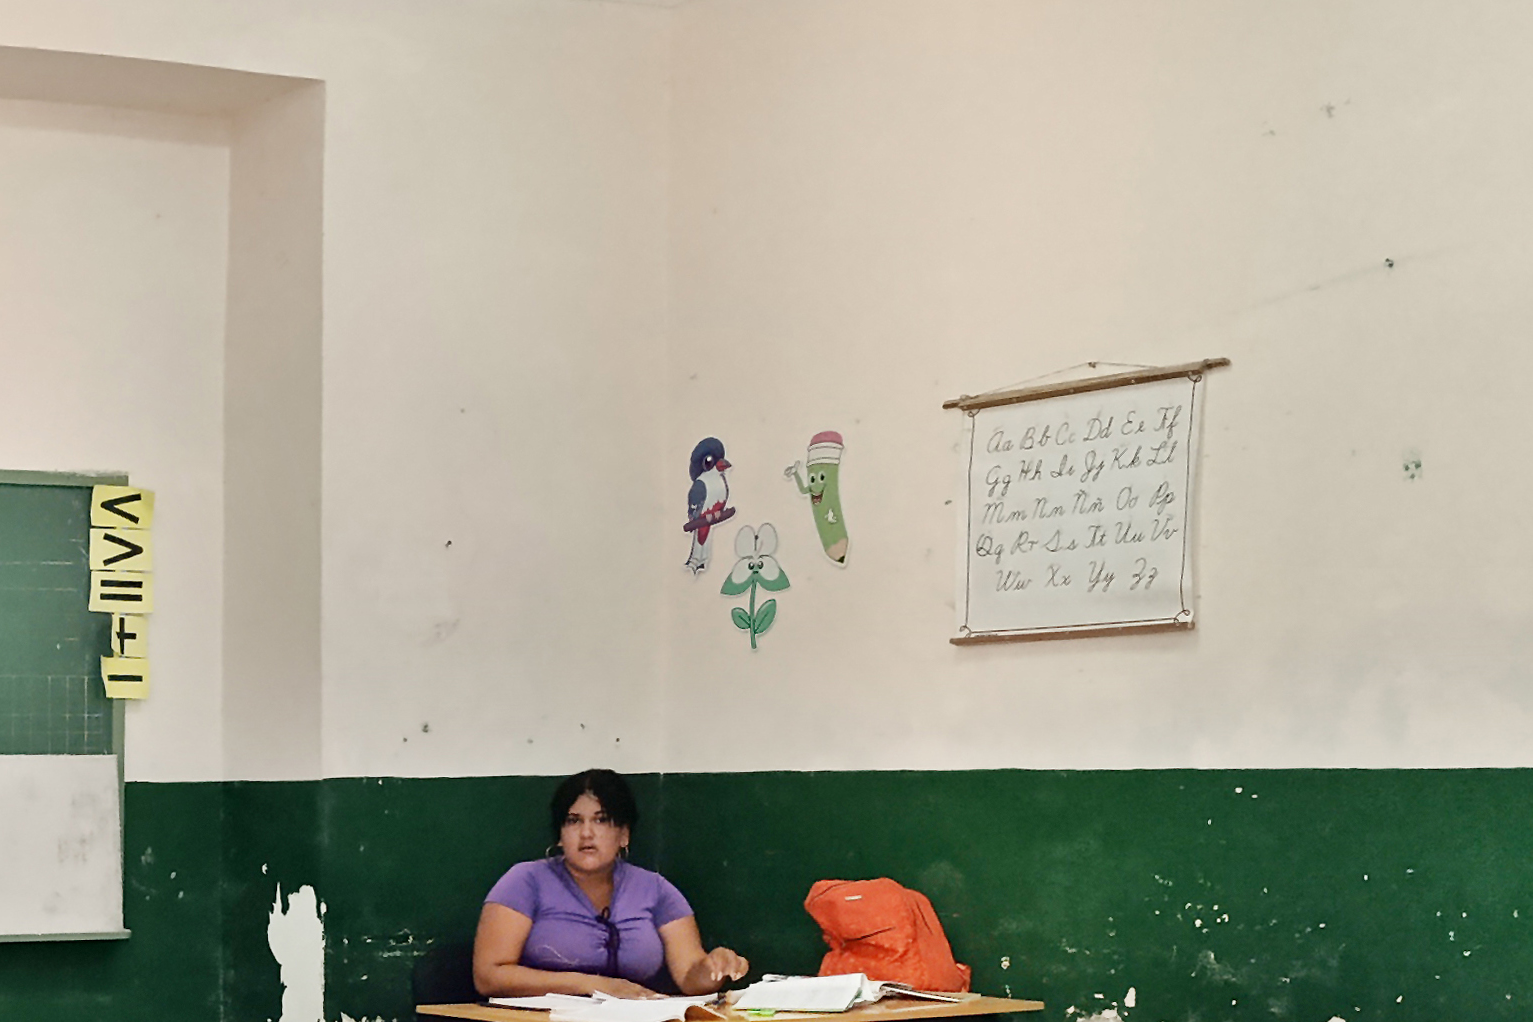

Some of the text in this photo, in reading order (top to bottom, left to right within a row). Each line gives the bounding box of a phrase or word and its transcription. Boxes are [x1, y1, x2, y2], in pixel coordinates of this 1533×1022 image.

[987, 430, 1014, 454] Aa
[1019, 427, 1051, 450] Bb
[1055, 422, 1076, 446] Cc
[1083, 416, 1114, 442] Dd
[1121, 410, 1145, 435] Ee
[985, 465, 1012, 496] Gg
[1018, 459, 1042, 482] Hh
[1110, 446, 1142, 471] Kk
[981, 481, 1176, 524] Mm Nn Ññ Oo Pp
[1010, 531, 1039, 555] Rr
[1044, 530, 1078, 552] Ss
[1083, 525, 1106, 548] Tt
[1114, 522, 1145, 544] Uu
[1151, 519, 1178, 541] Vv
[995, 557, 1159, 593] Ww Xx Yy Zz
